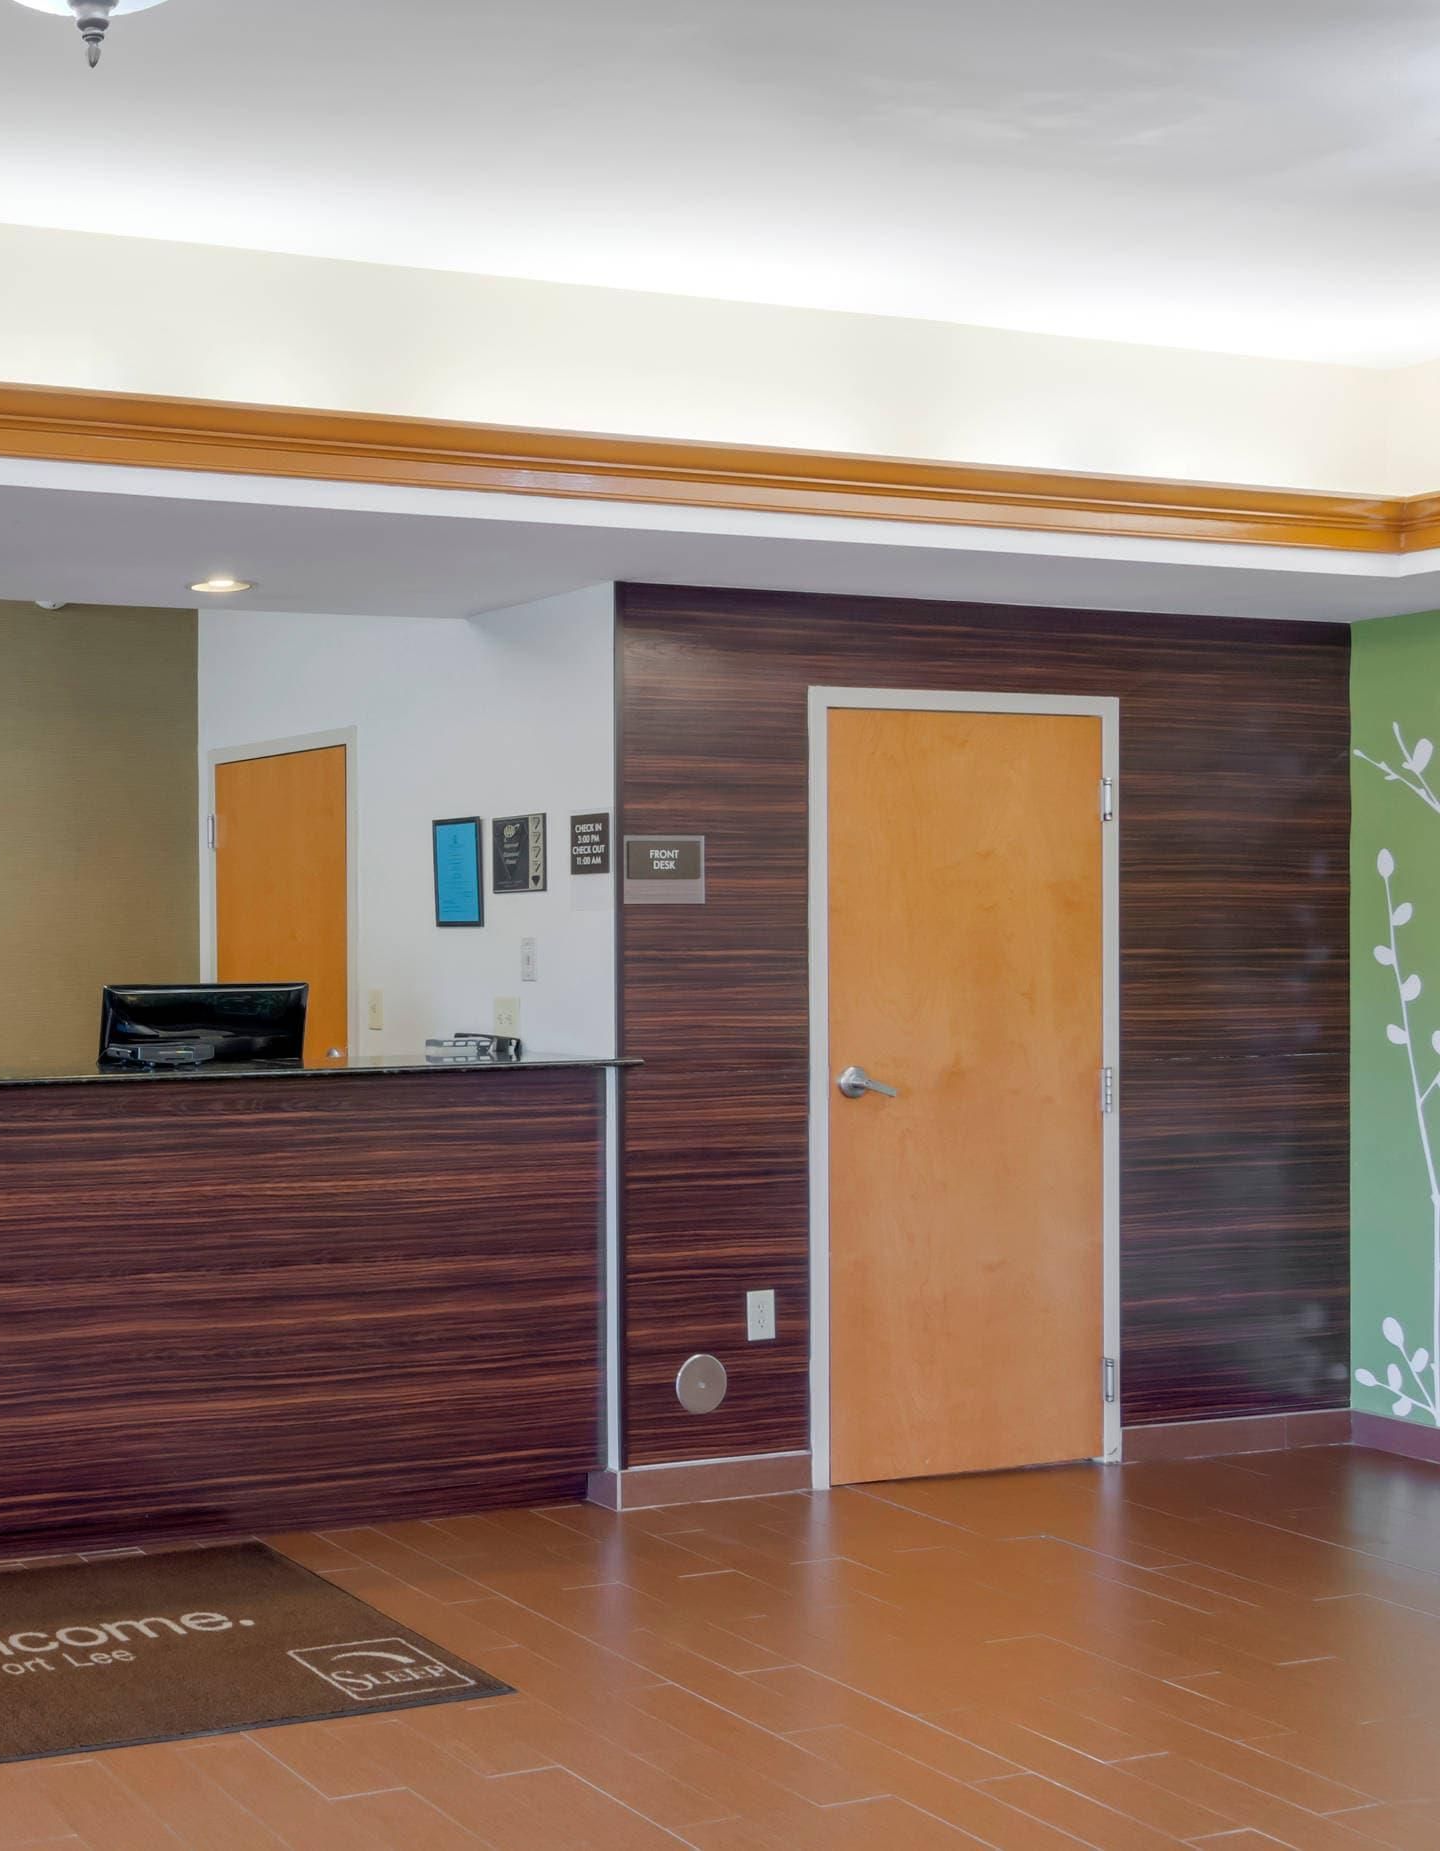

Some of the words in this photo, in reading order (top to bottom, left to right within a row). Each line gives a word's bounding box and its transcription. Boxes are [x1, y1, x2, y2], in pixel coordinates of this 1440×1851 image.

[574, 823, 594, 833] CHECK
[594, 822, 602, 831] IN
[591, 834, 600, 843] PM
[572, 845, 591, 855] CHECK
[592, 844, 605, 854] OUT
[649, 849, 679, 859] FRONT
[576, 856, 591, 865] 11:00
[591, 855, 602, 865] AM
[652, 860, 676, 870] DESK
[62, 1648, 137, 1668] Lee
[330, 1664, 447, 1692] SLEEP
